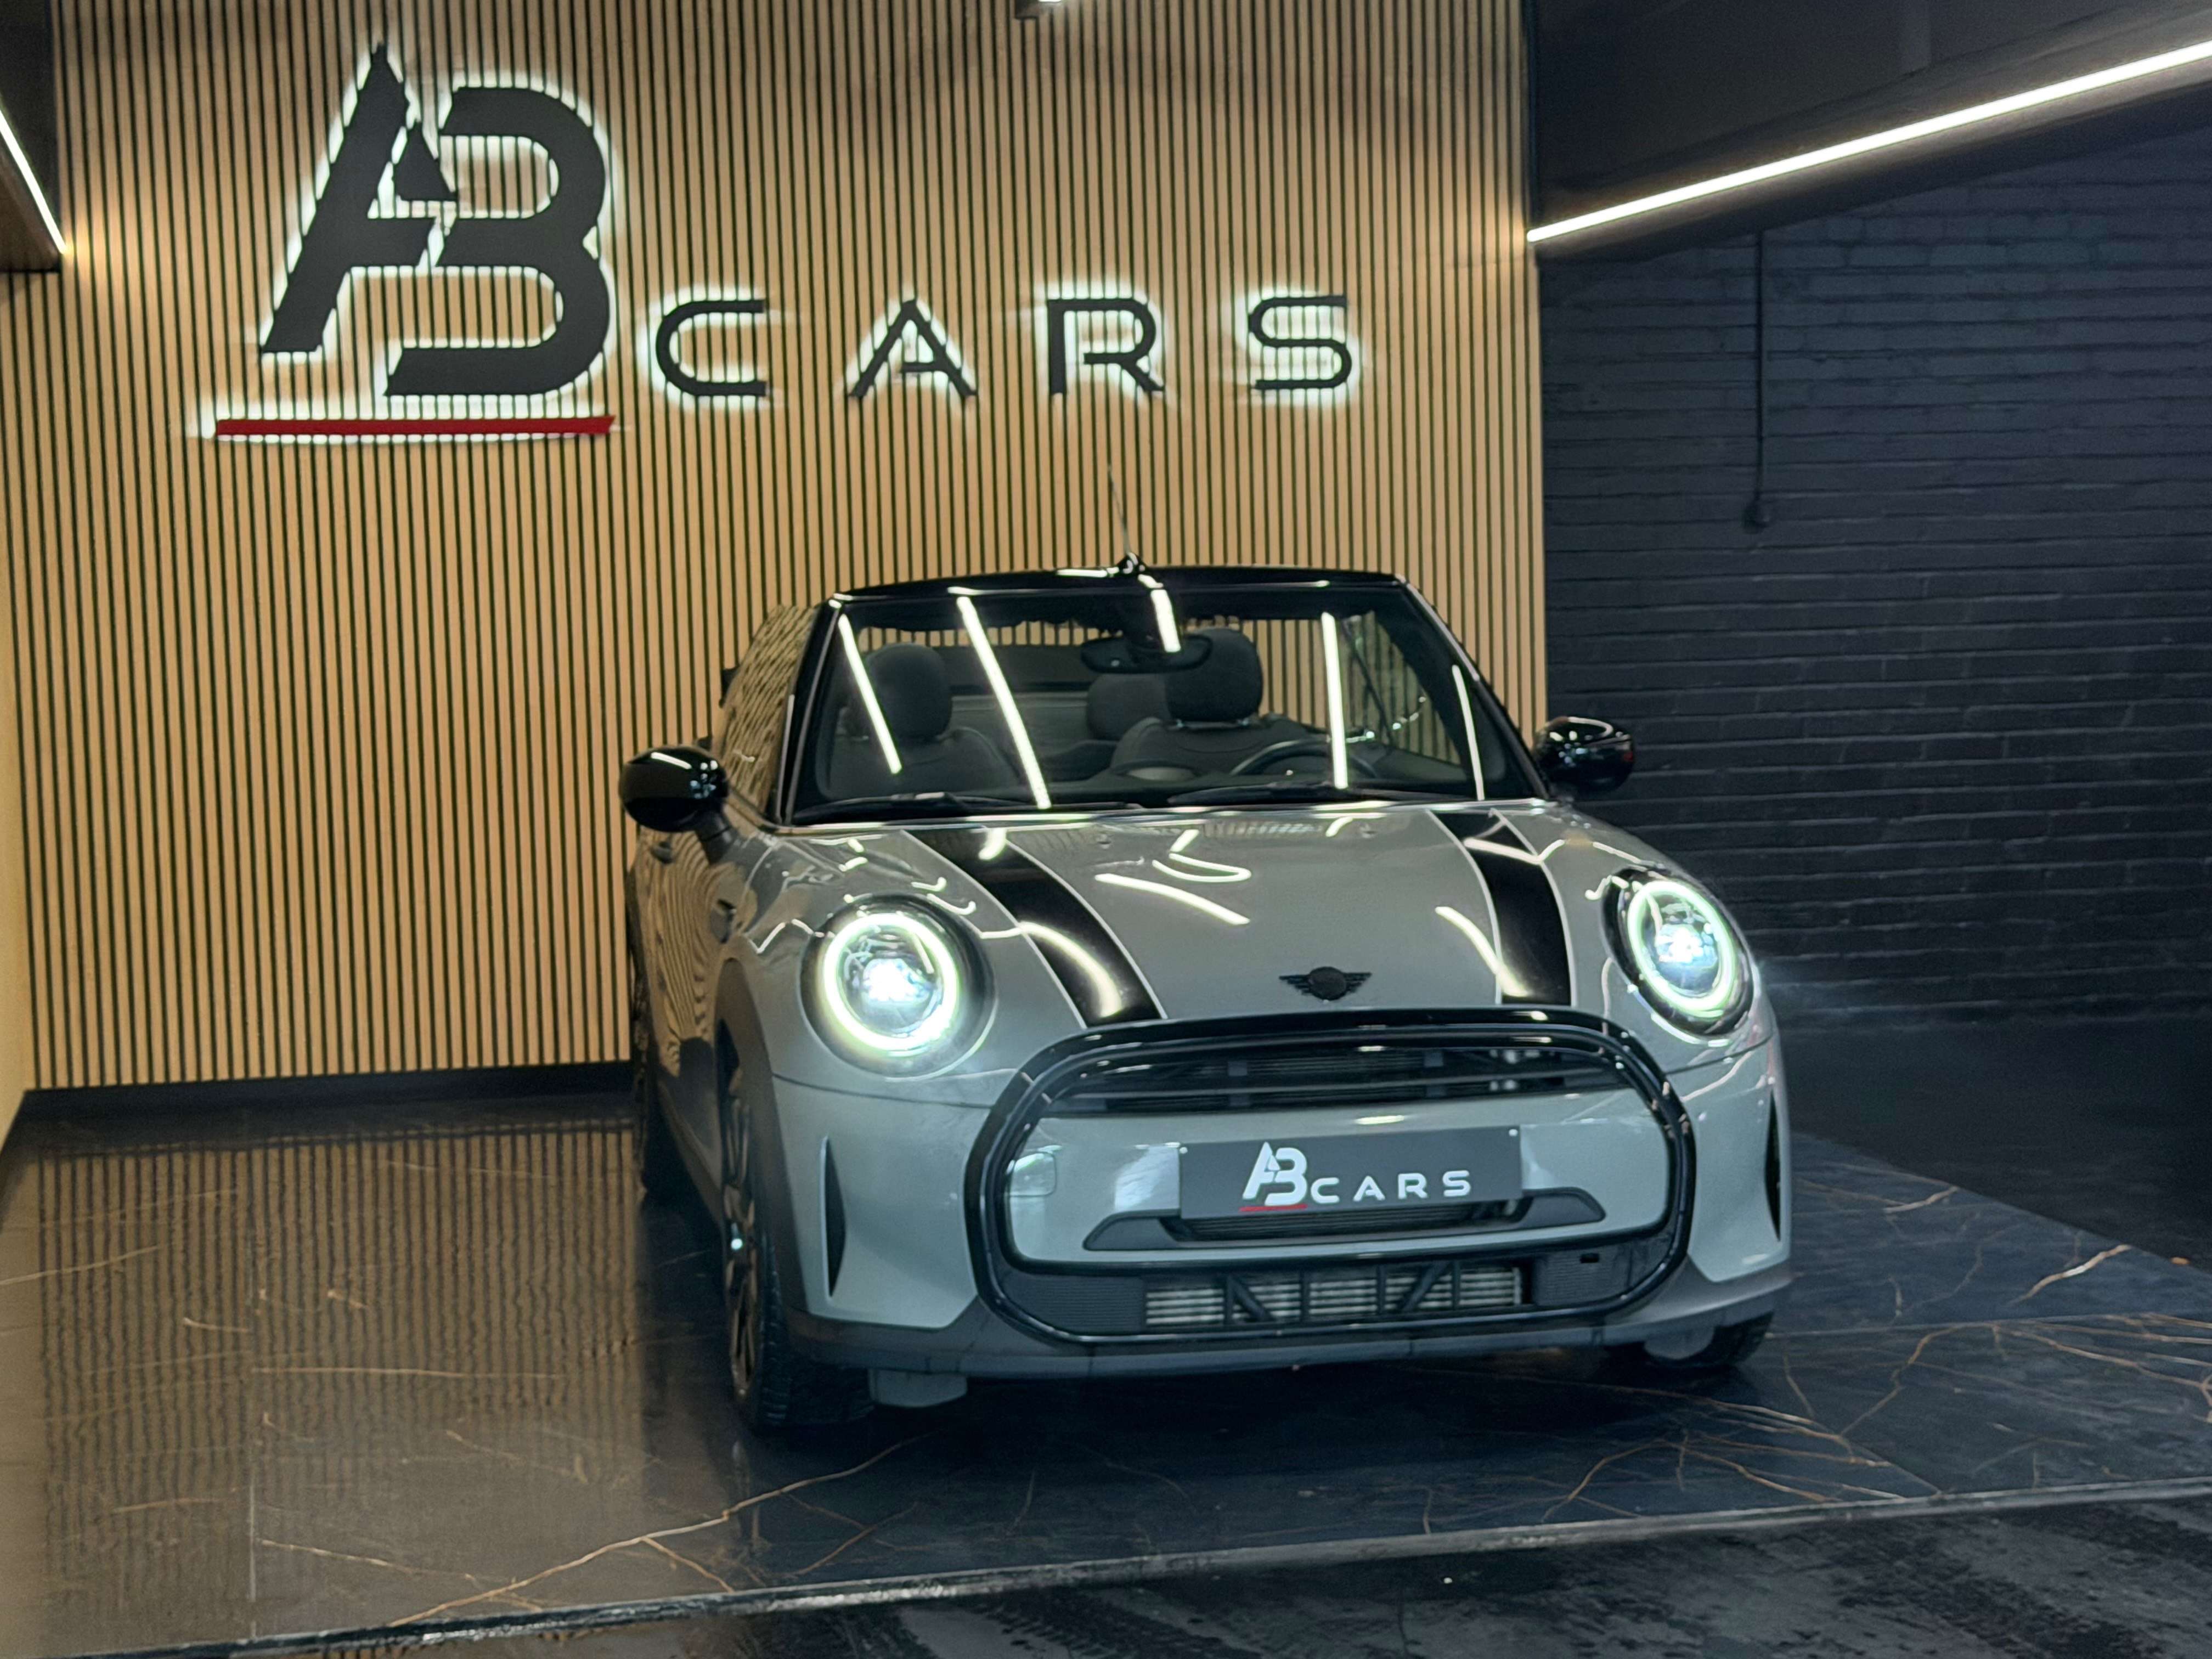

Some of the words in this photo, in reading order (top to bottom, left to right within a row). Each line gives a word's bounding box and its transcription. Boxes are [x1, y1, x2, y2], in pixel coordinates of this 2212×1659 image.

[261, 42, 610, 396] AB
[656, 295, 1352, 399] CARS
[1242, 1142, 1308, 1206] AB
[1310, 1170, 1471, 1204] CARS
